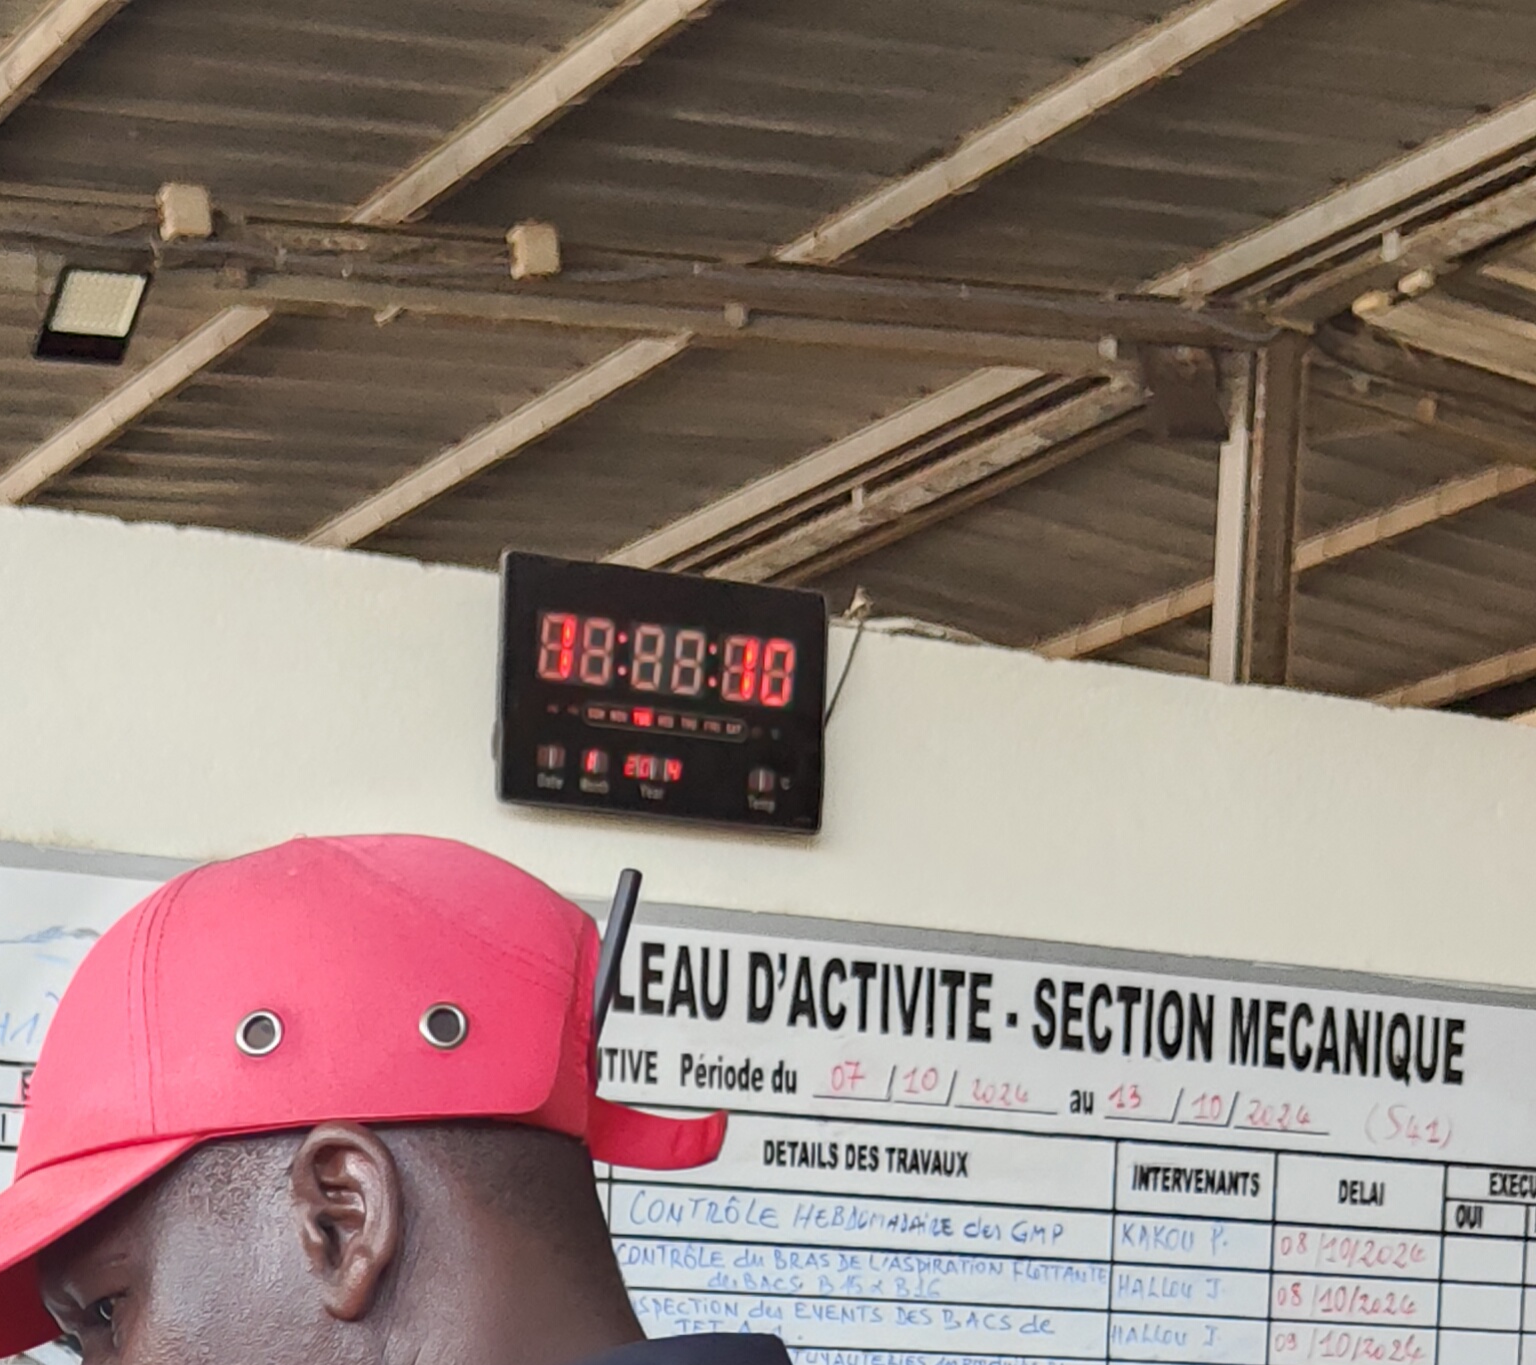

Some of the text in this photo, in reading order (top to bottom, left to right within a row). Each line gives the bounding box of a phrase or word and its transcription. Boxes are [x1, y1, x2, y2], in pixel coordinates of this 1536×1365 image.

[610, 941, 730, 1021] LEAU
[746, 950, 994, 1045] D'ACTIVITE
[1031, 977, 1215, 1063] SECTION
[1228, 996, 1467, 1087] MECANIQUE
[597, 1047, 798, 1095] TIVE Période du
[1069, 1090, 1095, 1115] au
[763, 1138, 970, 1178] DETAILS DES TRAVAUX
[1131, 1162, 1261, 1198] INTERVENANTS
[1338, 1178, 1386, 1207] DELAI
[629, 1188, 780, 1230] CONTRÔLE
[1011, 1220, 1065, 1246] GMP
[1455, 1204, 1484, 1231] OUI
[1120, 1221, 1195, 1253] KAKOU
[773, 1249, 831, 1271] BRAS
[629, 1296, 739, 1319] SPECTION
[942, 1308, 1013, 1332] BACS
[1018, 1313, 1056, 1335] de
